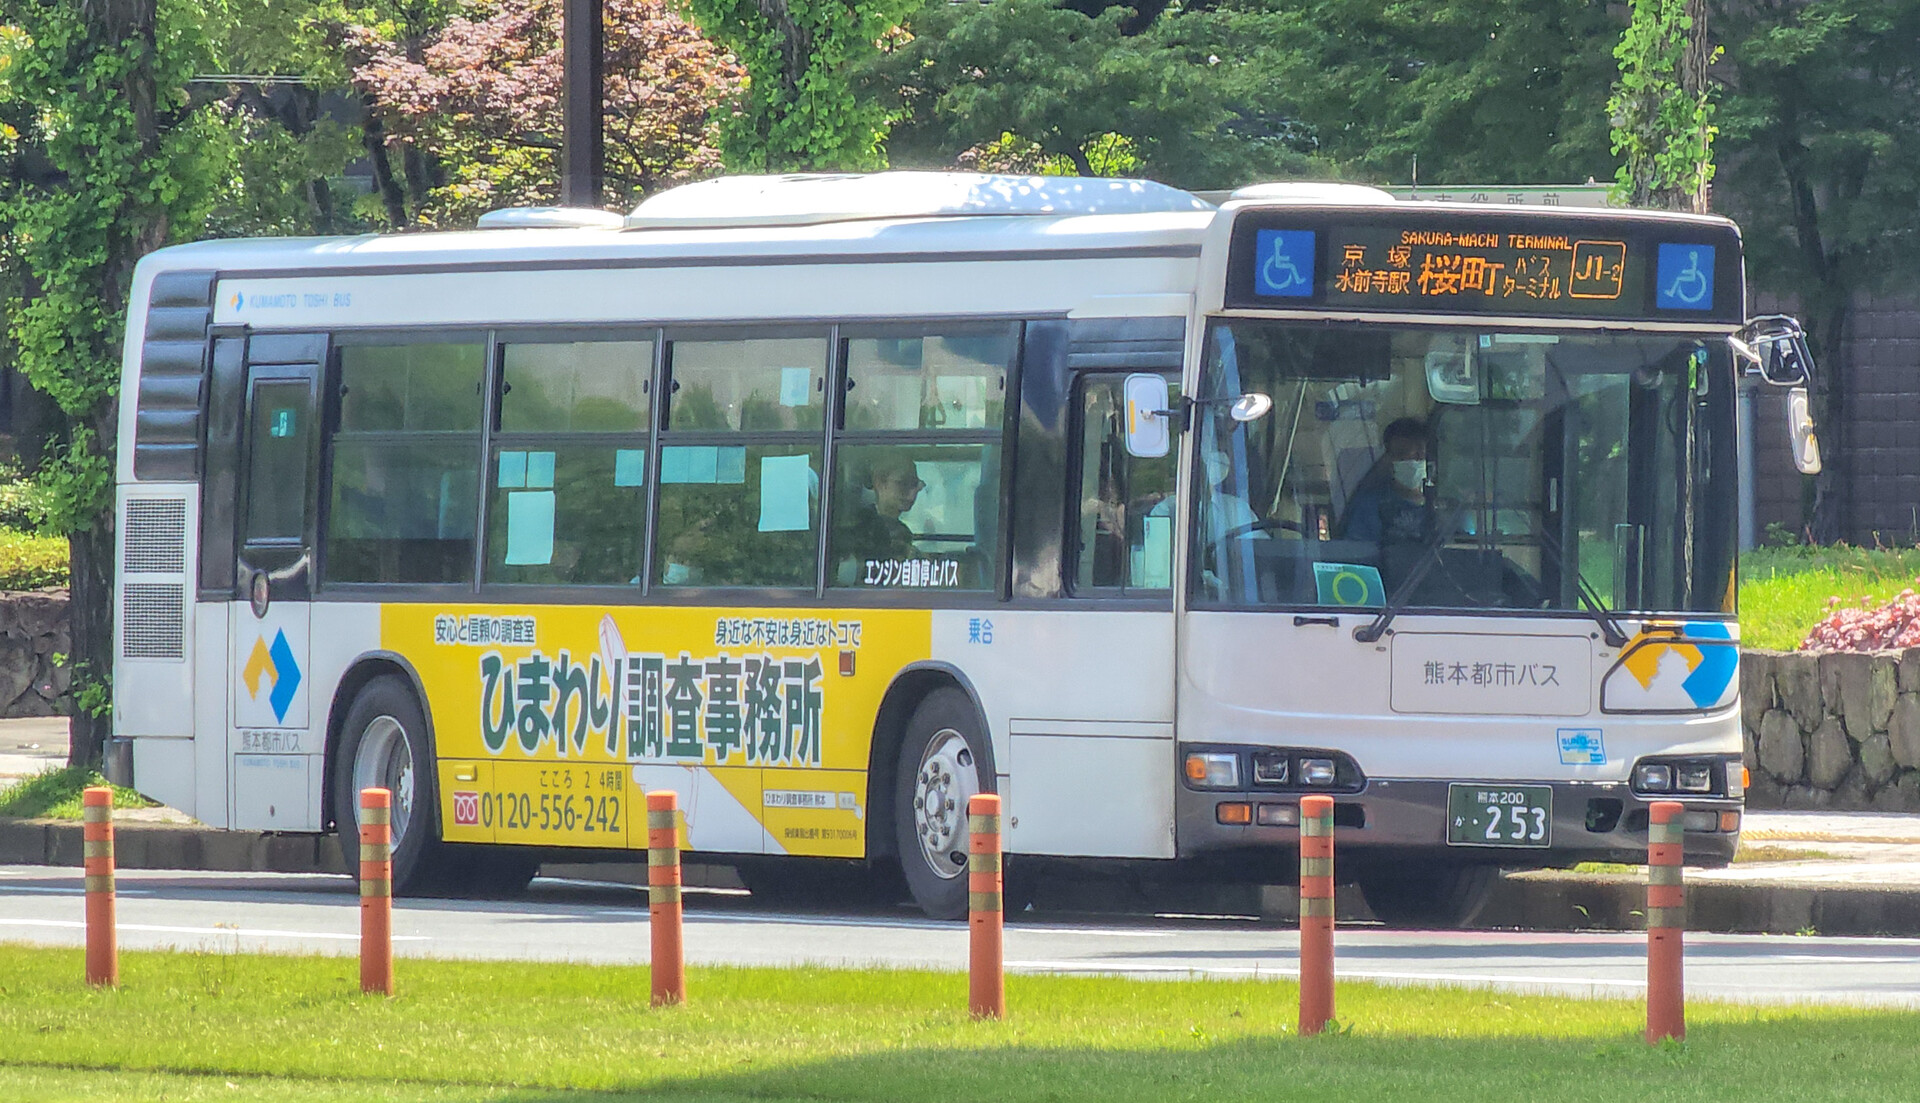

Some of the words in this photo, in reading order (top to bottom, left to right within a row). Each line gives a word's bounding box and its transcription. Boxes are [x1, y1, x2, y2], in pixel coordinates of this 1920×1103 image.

[1401, 231, 1499, 248] SAKURA-MACHI
[1508, 234, 1572, 250] TERMINAL
[1417, 253, 1504, 295] 桜町
[1515, 255, 1550, 277] バス
[1575, 255, 1620, 281] J1-2
[1334, 268, 1411, 294] 水前寺駅
[1503, 275, 1561, 299] ターミナル
[249, 294, 297, 308] KUMAMOTO
[303, 293, 329, 308] TOSHI
[333, 293, 351, 307] BUS
[864, 559, 959, 587] エンジン自動停止バス
[435, 617, 535, 643] 安心と信頼の調査室
[715, 619, 861, 646] 身近な不安は身近なトコで
[968, 618, 993, 644] 乗合
[1423, 660, 1560, 688] 熊本都市バス
[481, 652, 822, 763] ひまわり調査事務所
[242, 731, 301, 752] 熊本都市バス
[540, 770, 572, 789] こころ
[481, 792, 621, 832] 0120-556-242
